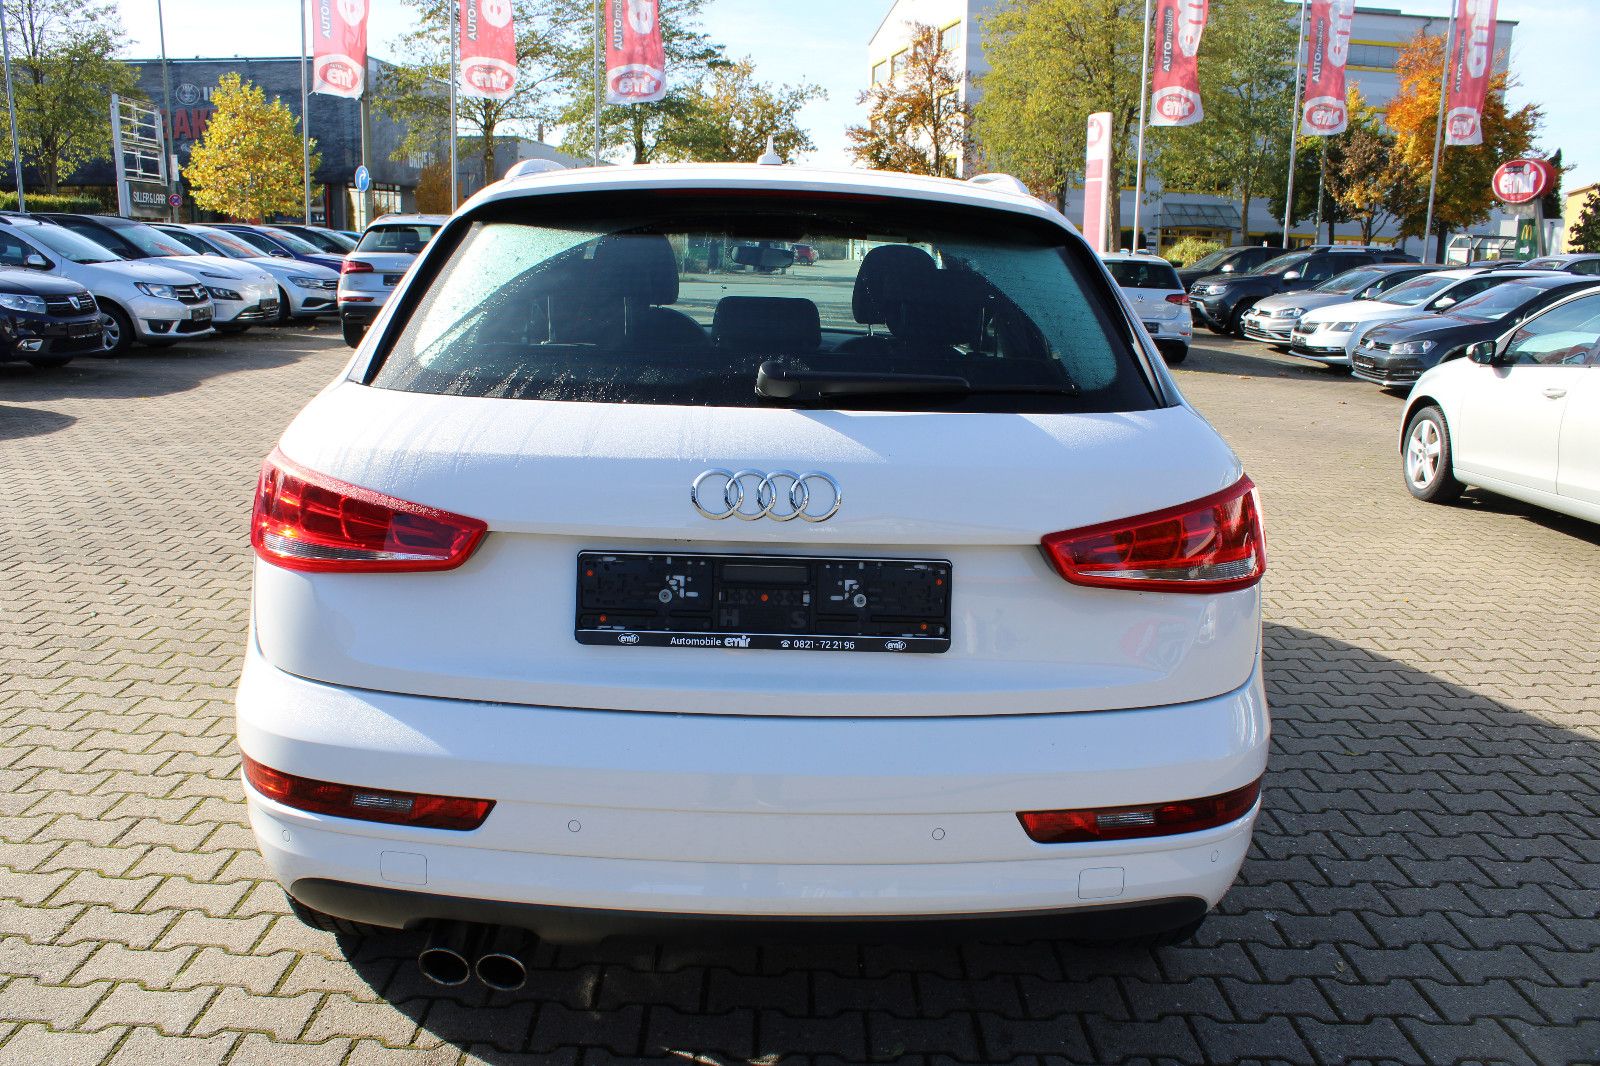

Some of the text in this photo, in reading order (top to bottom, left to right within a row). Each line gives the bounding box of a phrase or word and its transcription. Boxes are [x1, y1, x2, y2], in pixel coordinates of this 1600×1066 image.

[1162, 9, 1174, 72] AUTOmobile
[1499, 163, 1537, 194] emir
[620, 634, 637, 645] emir
[670, 634, 751, 648] Automobile emir
[887, 640, 904, 650] emir
